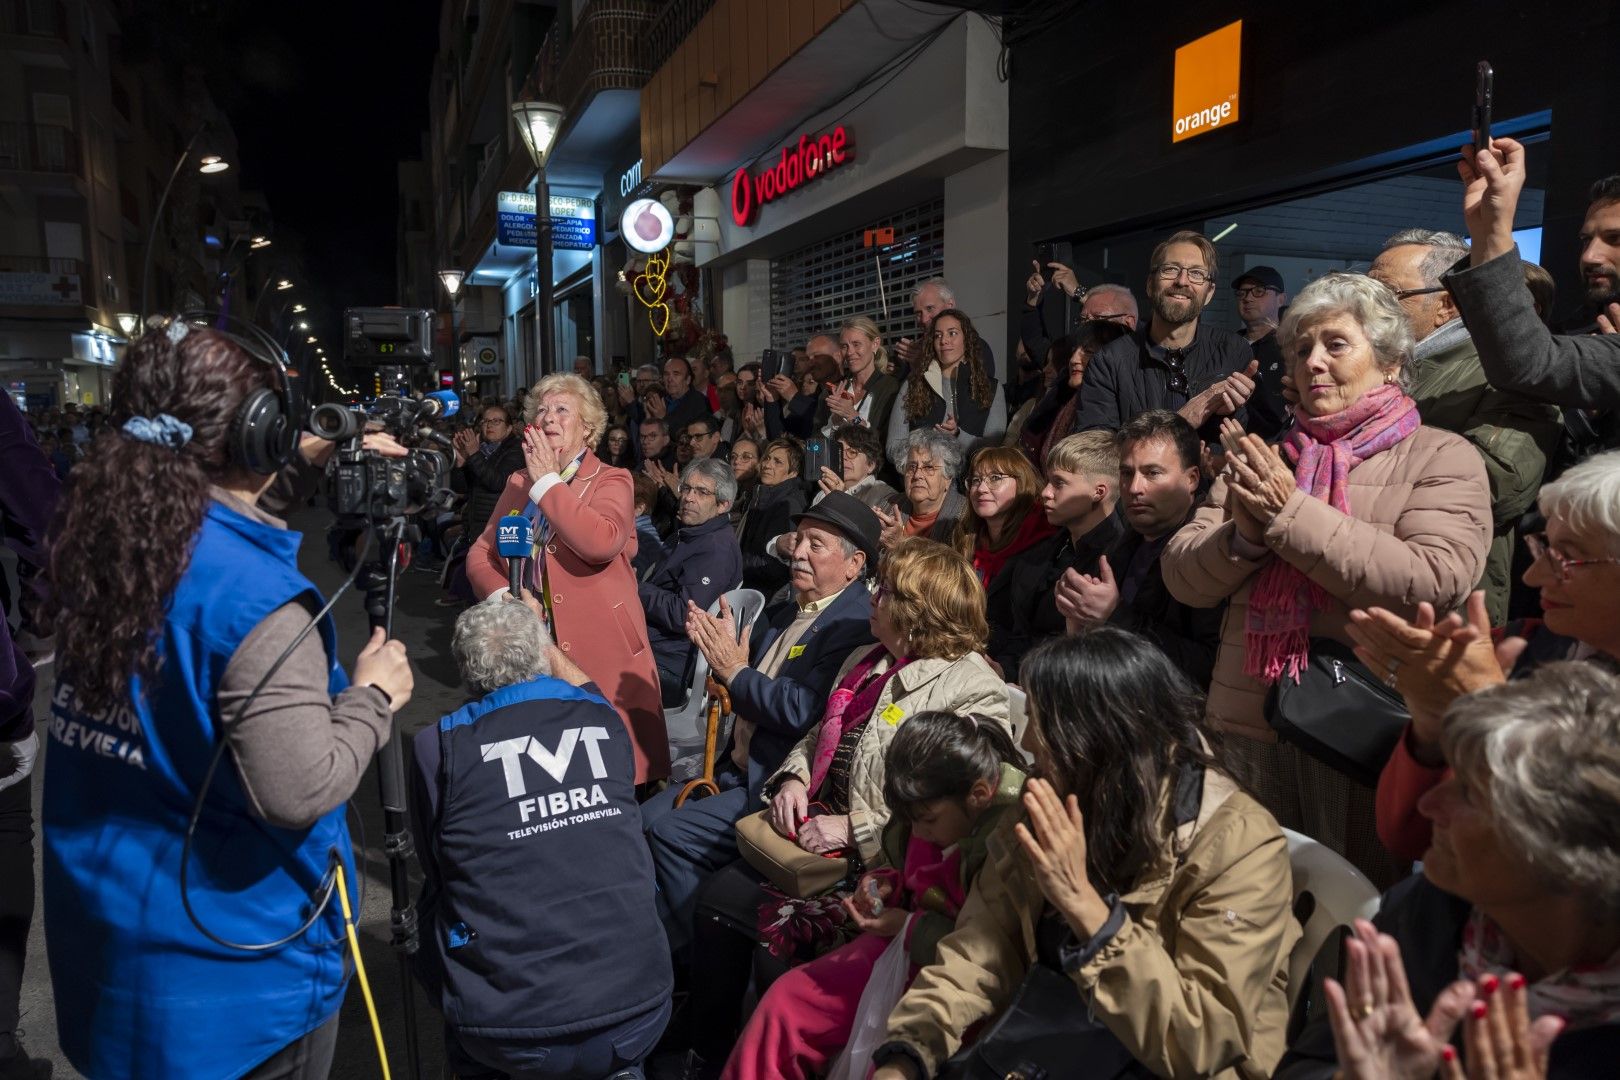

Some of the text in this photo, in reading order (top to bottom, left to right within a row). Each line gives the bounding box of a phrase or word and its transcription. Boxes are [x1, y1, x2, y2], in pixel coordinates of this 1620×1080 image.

[1175, 101, 1231, 134] orange
[754, 124, 847, 204] vodafone
[501, 214, 525, 222] DOLOR
[499, 526, 519, 535] TVT
[480, 726, 610, 799] TVT
[518, 784, 609, 823] FIBRA
[507, 807, 622, 840] TELEVISIÓN TORREVIEJA
